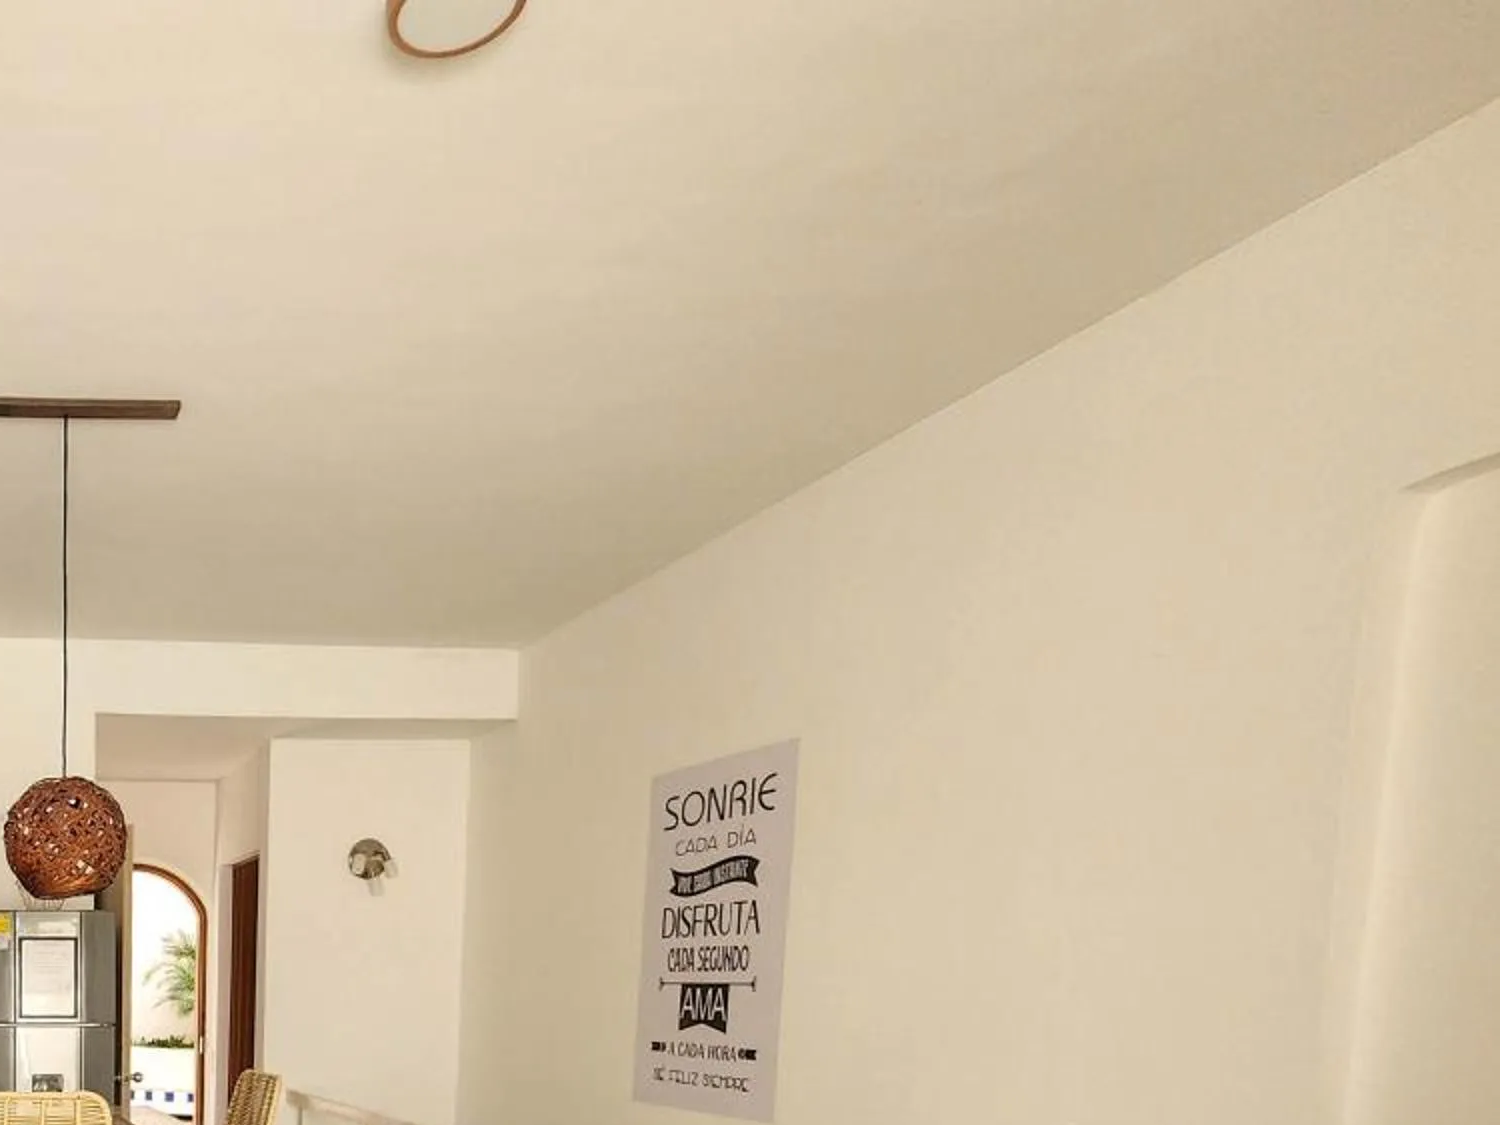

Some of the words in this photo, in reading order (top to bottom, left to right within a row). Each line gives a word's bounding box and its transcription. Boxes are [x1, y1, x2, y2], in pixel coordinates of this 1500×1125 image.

[664, 771, 778, 831] SONRIE
[675, 834, 718, 857] CADA
[661, 899, 760, 939] DISFRUTA
[667, 948, 696, 973] CADA
[697, 945, 750, 972] SEGUNDO
[680, 987, 727, 1021] AMA
[677, 1041, 705, 1059] CADA
[707, 1044, 737, 1062] HORA
[668, 1069, 699, 1087] FELIZ
